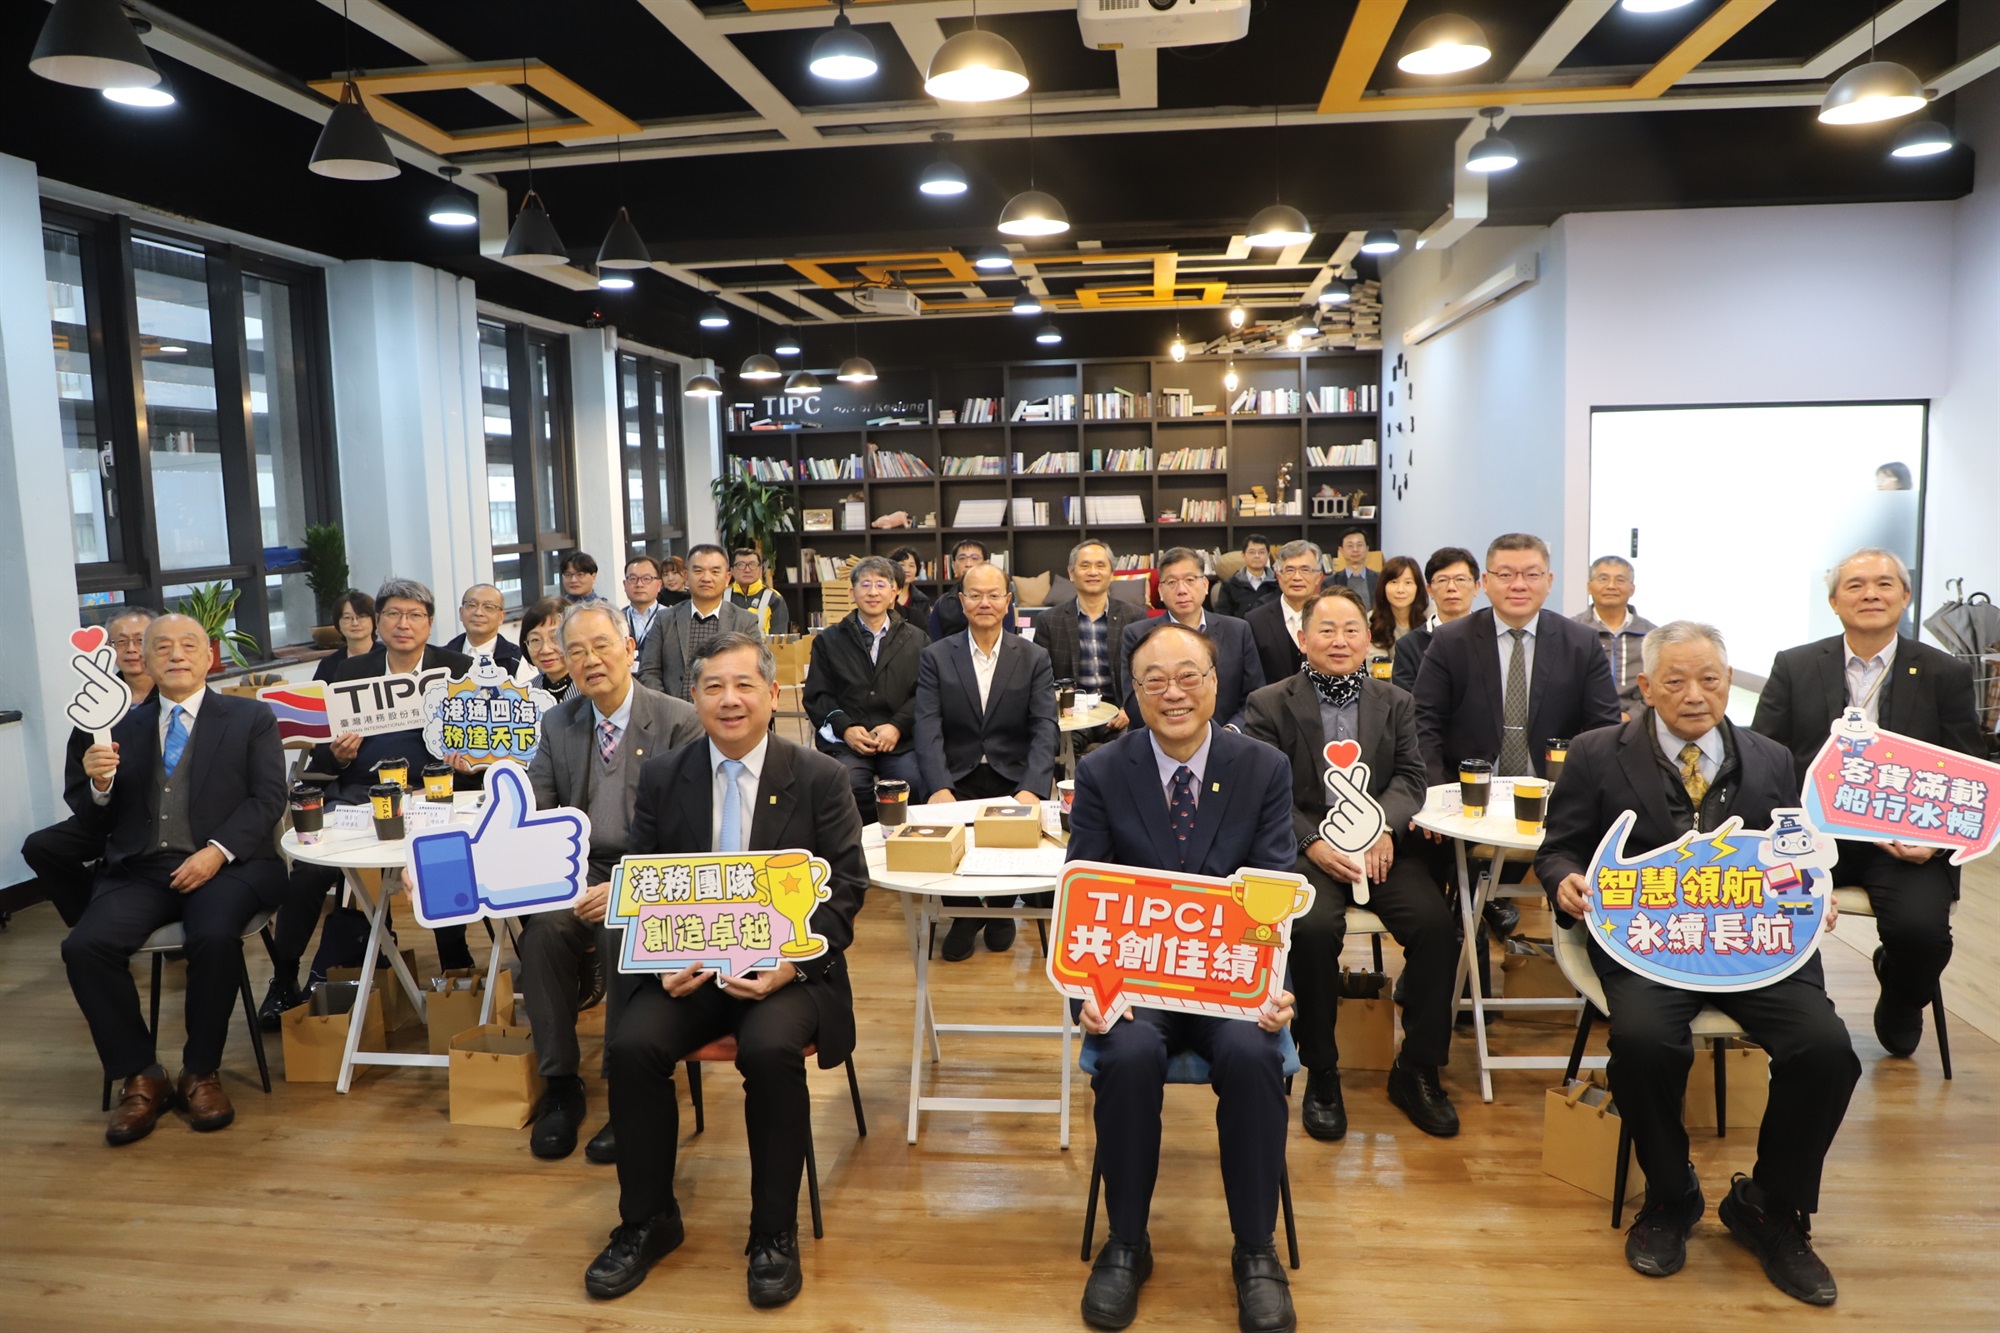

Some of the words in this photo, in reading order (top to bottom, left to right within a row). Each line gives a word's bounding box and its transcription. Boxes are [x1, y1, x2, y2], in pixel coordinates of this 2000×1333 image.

[762, 396, 821, 416] TIPC
[340, 708, 420, 728] 臺灣港務股份有
[364, 721, 407, 732] INTERNATIONAL
[407, 718, 426, 726] PORTS
[442, 697, 537, 724] 港通四海
[443, 725, 536, 751] 務達天下
[1839, 756, 1988, 810] 客貨滿載
[1833, 784, 1984, 840] 船行水暢
[630, 862, 757, 902] 港務團隊
[1598, 864, 1765, 909] 智慧領航
[641, 912, 772, 952] 創造卓越
[1087, 891, 1224, 937] TIPC!
[1626, 911, 1795, 955] 永續長航
[1067, 924, 1259, 985] 共創佳績
